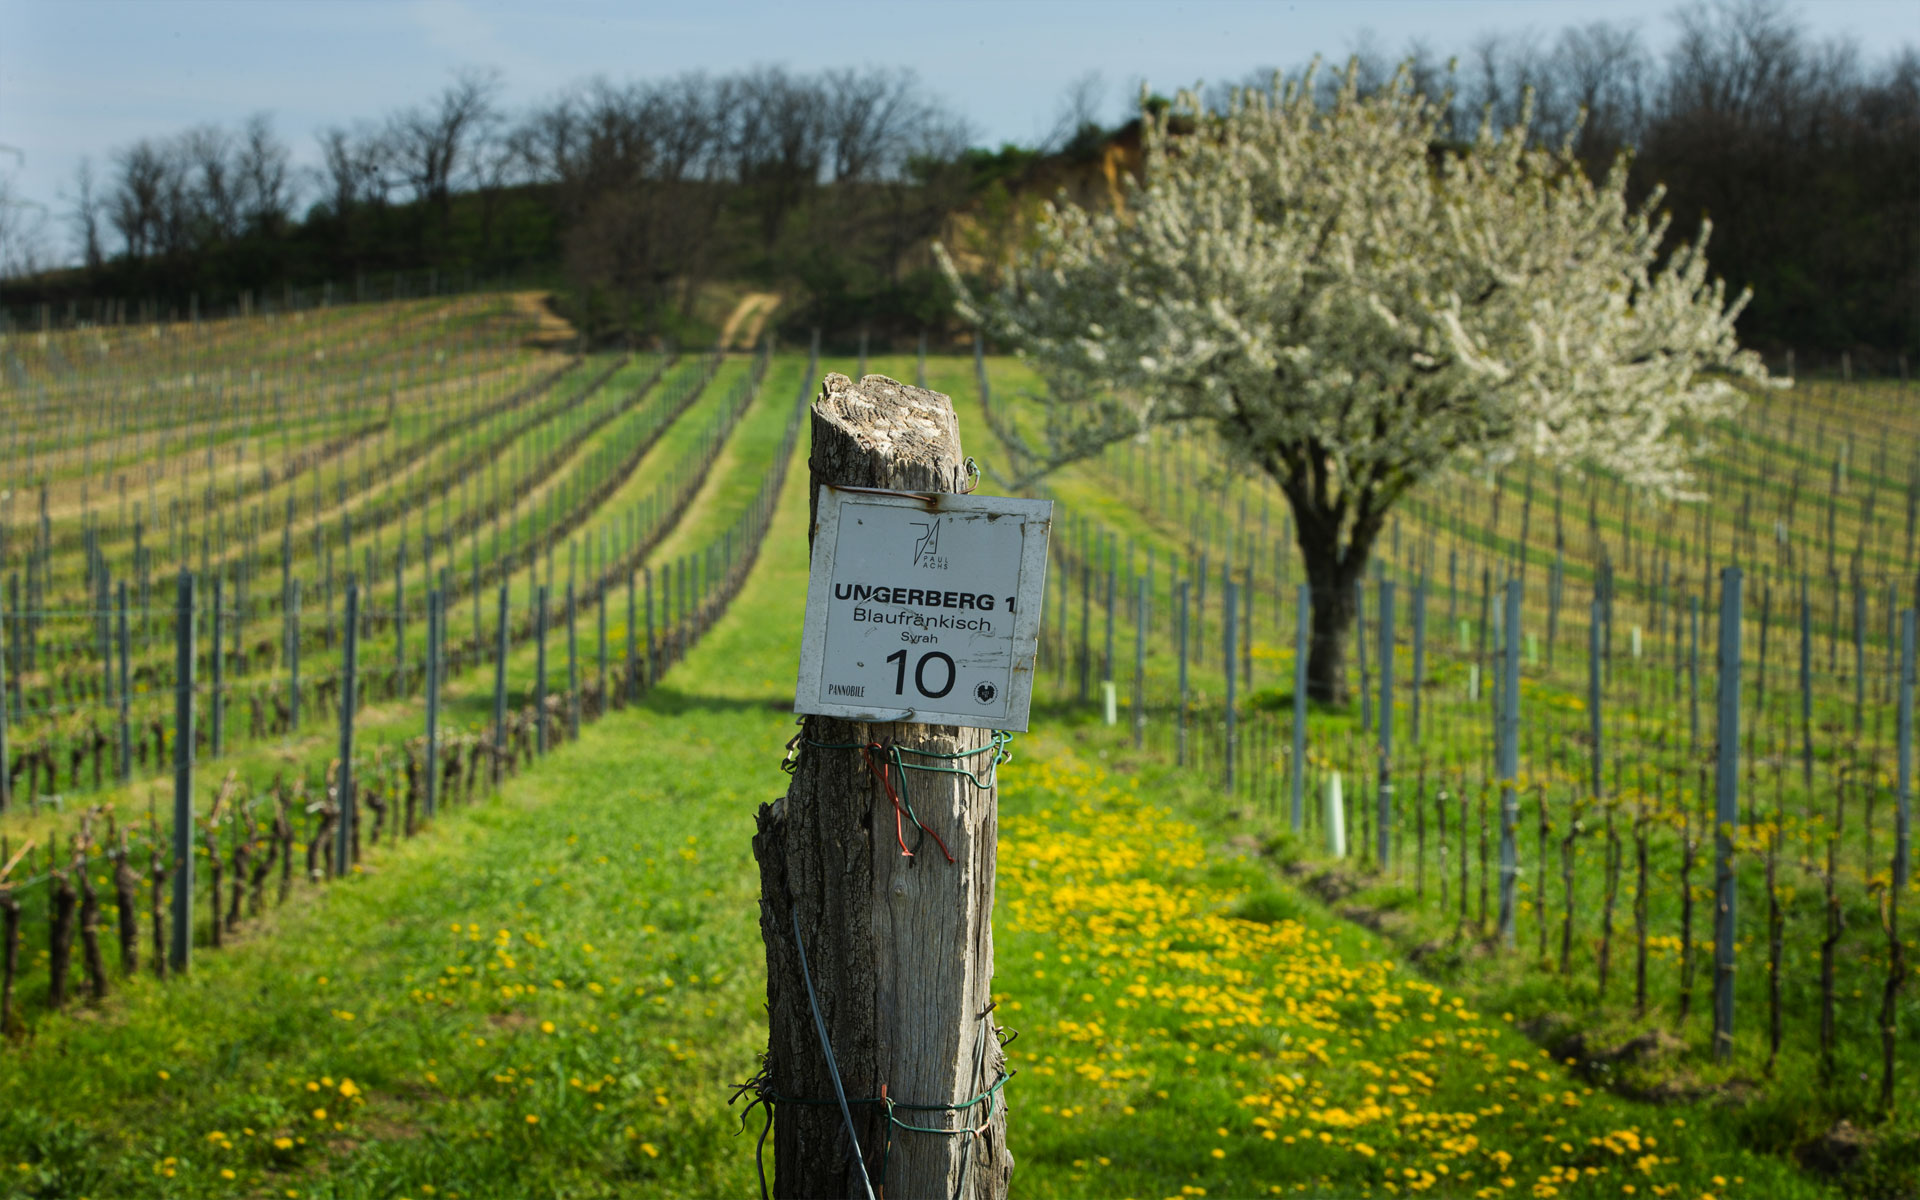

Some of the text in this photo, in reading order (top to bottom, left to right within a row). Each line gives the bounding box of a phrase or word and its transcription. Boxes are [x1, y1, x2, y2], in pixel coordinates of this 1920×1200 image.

[922, 562, 948, 570] ACHS
[923, 555, 949, 563] PAUL
[834, 583, 1016, 612] UNGERBERG 1
[853, 607, 991, 631] Blaufränkisch
[900, 631, 938, 644] Syrah
[886, 649, 956, 699] 10
[828, 683, 865, 698] PANNOBILE
